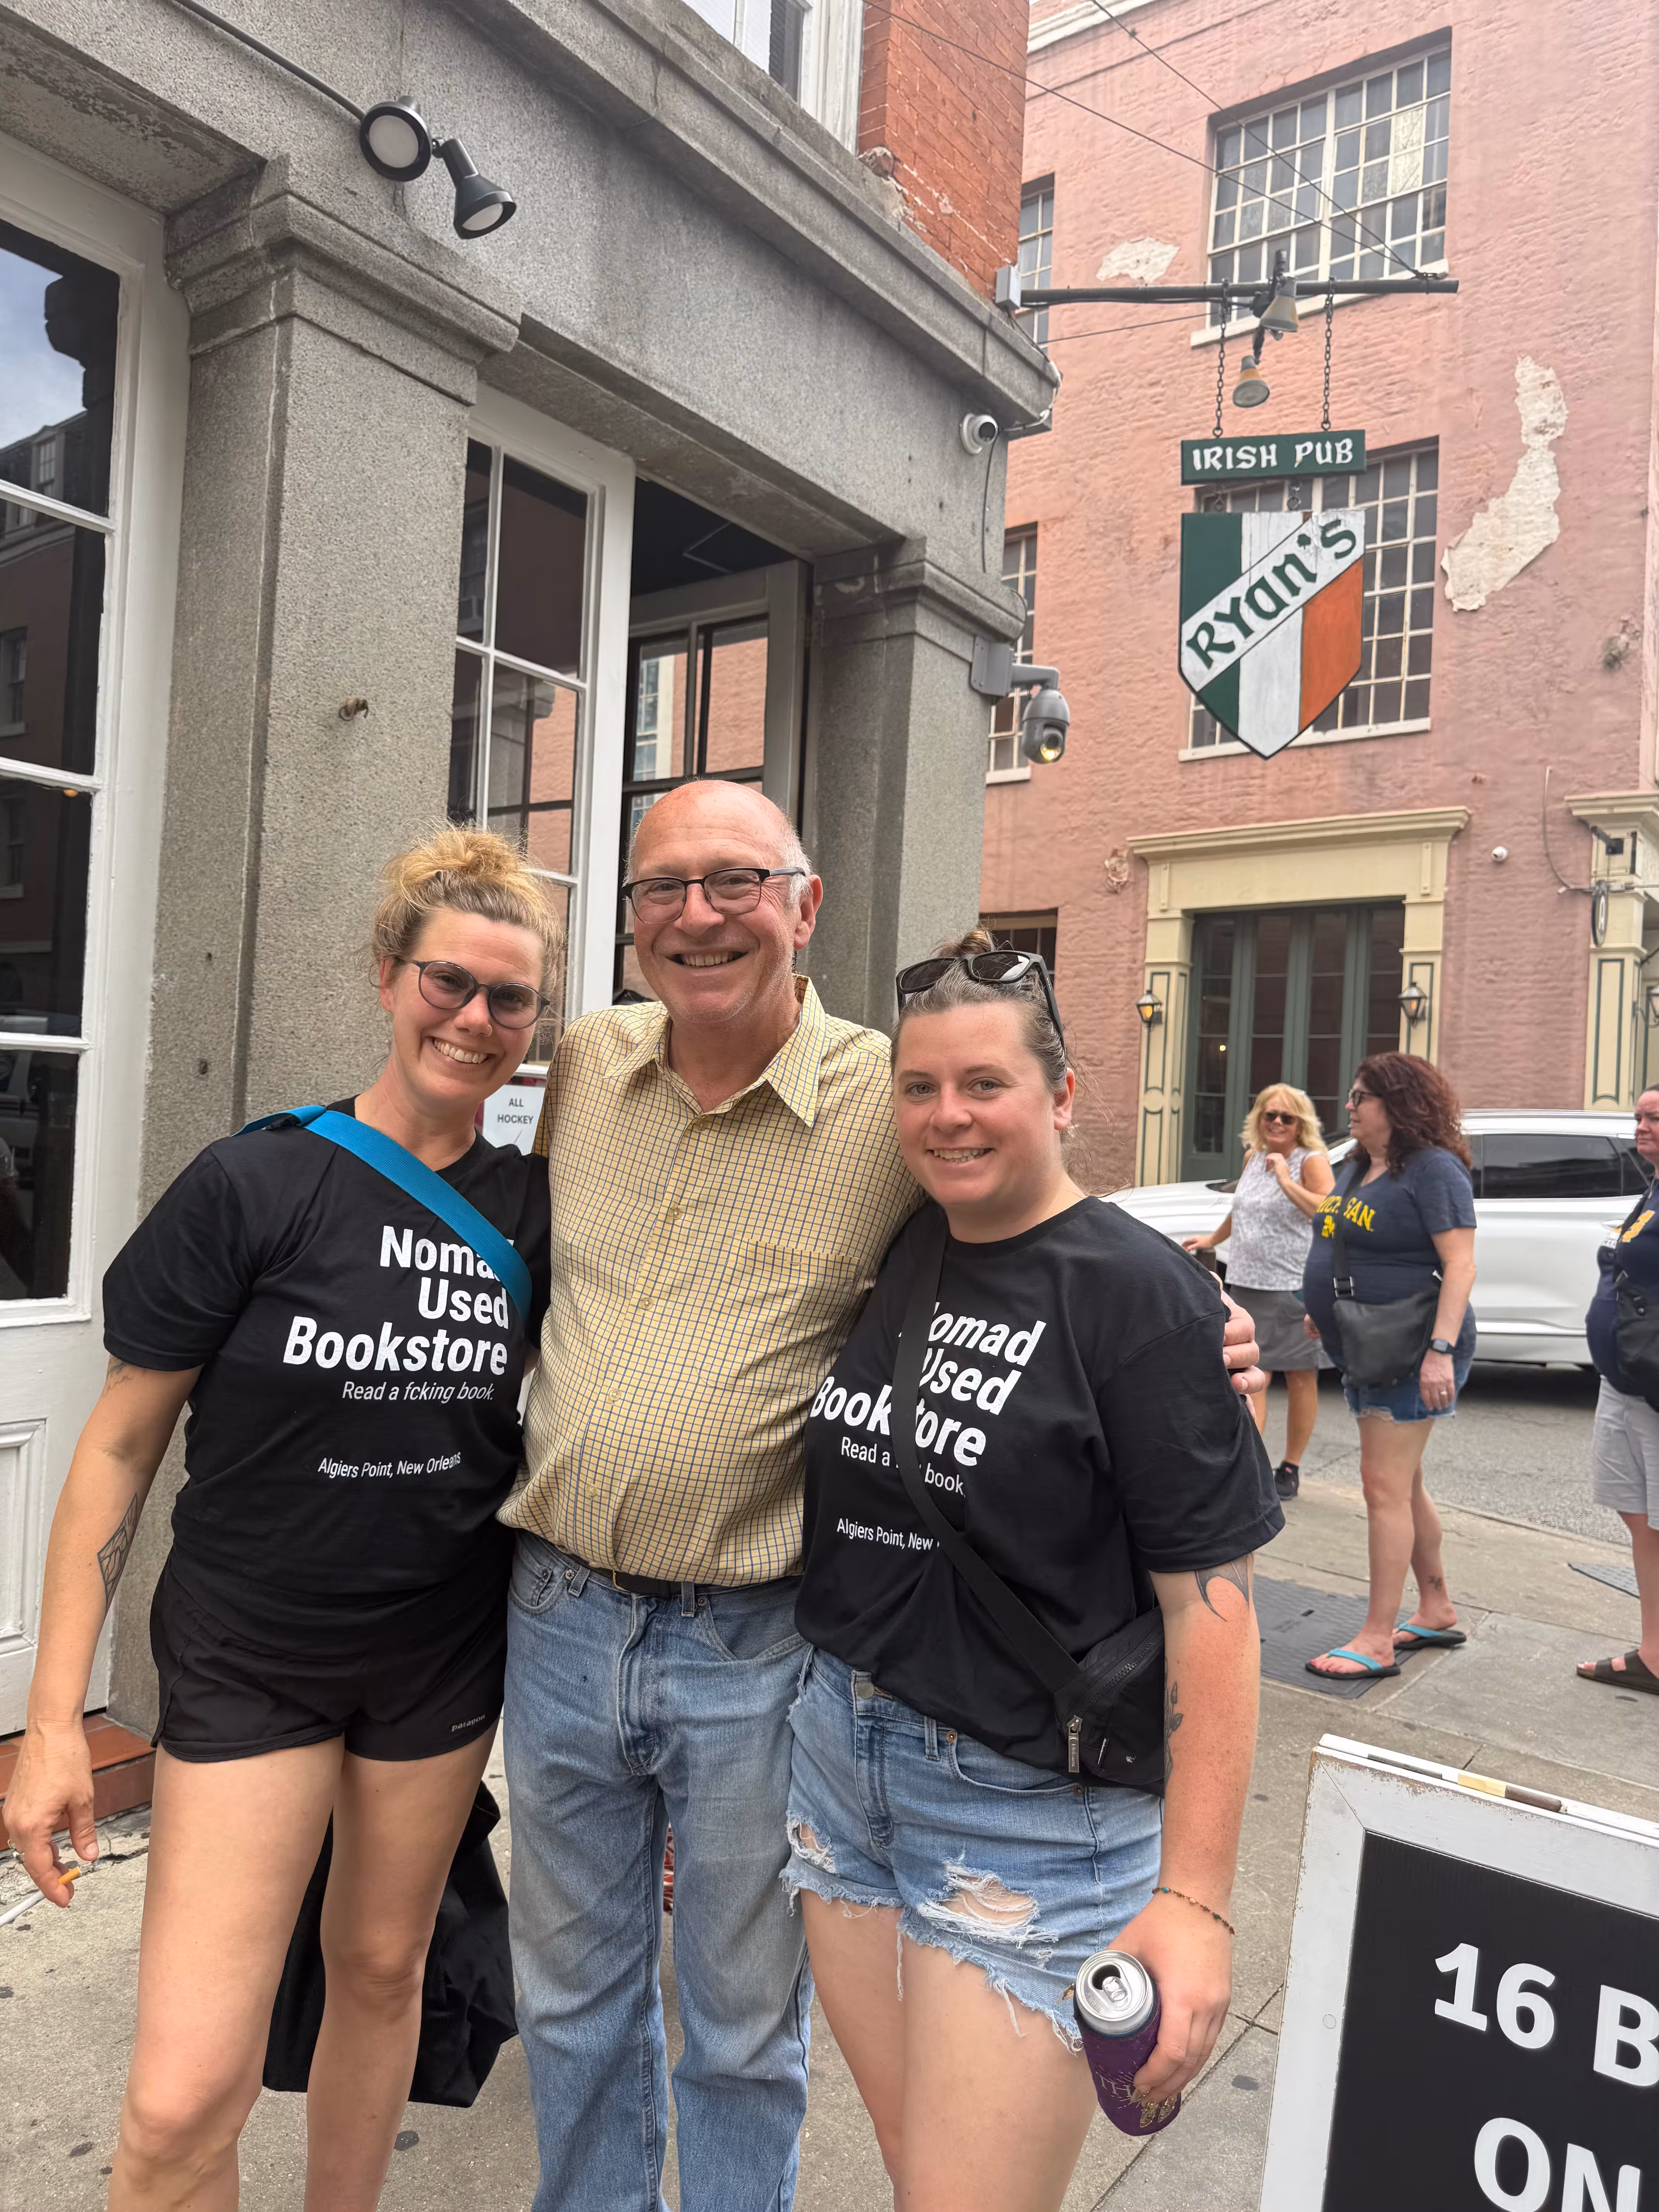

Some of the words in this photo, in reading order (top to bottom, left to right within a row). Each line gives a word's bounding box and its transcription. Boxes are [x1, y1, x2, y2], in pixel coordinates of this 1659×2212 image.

[1192, 443, 1277, 471] IRISH
[1294, 438, 1353, 468] PUB
[497, 1114, 534, 1124] HOCKEY
[508, 1098, 524, 1107] ALL
[380, 1226, 515, 1282] Noma
[418, 1277, 509, 1329] Used
[283, 1316, 508, 1375] Bookstore
[898, 1302, 1046, 1366] omad
[342, 1381, 386, 1400] Read
[388, 1386, 399, 1400] a
[403, 1381, 455, 1404] fcking
[457, 1382, 495, 1400] book.
[810, 1376, 986, 1466] Booktore
[318, 1458, 359, 1479] Algiers
[361, 1462, 393, 1478] Point,
[397, 1460, 424, 1475] New
[426, 1451, 461, 1474] Orleans
[841, 1436, 877, 1463] Read
[881, 1451, 890, 1467] a
[837, 1518, 874, 1540] Algiers
[876, 1526, 905, 1549] Point,
[908, 1532, 934, 1550] New
[1434, 1942, 1556, 2049] 16
